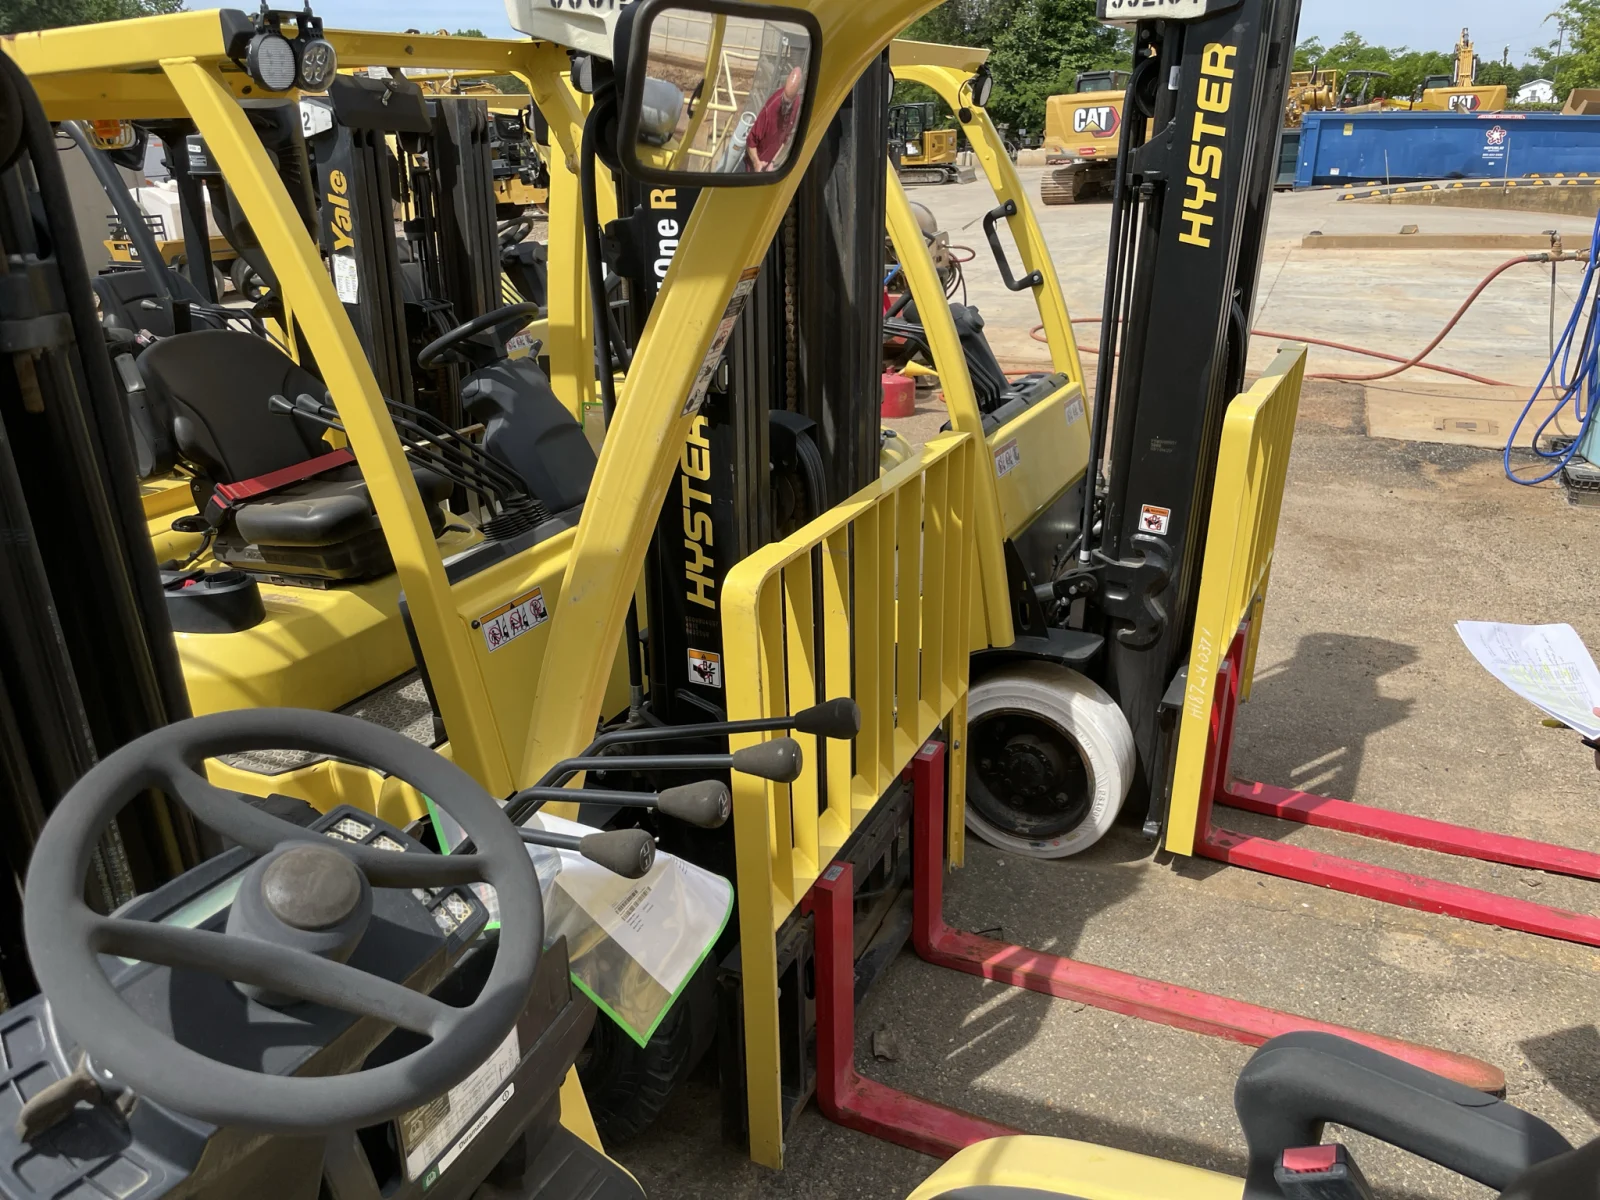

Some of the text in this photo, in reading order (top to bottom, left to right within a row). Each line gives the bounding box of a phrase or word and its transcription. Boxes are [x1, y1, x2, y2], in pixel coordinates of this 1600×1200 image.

[1074, 106, 1109, 132] CAT
[1179, 43, 1237, 248] HYSTER
[327, 169, 354, 250] Yale
[681, 415, 716, 610] HYSTER
[458, 1115, 488, 1149] Duramatch
